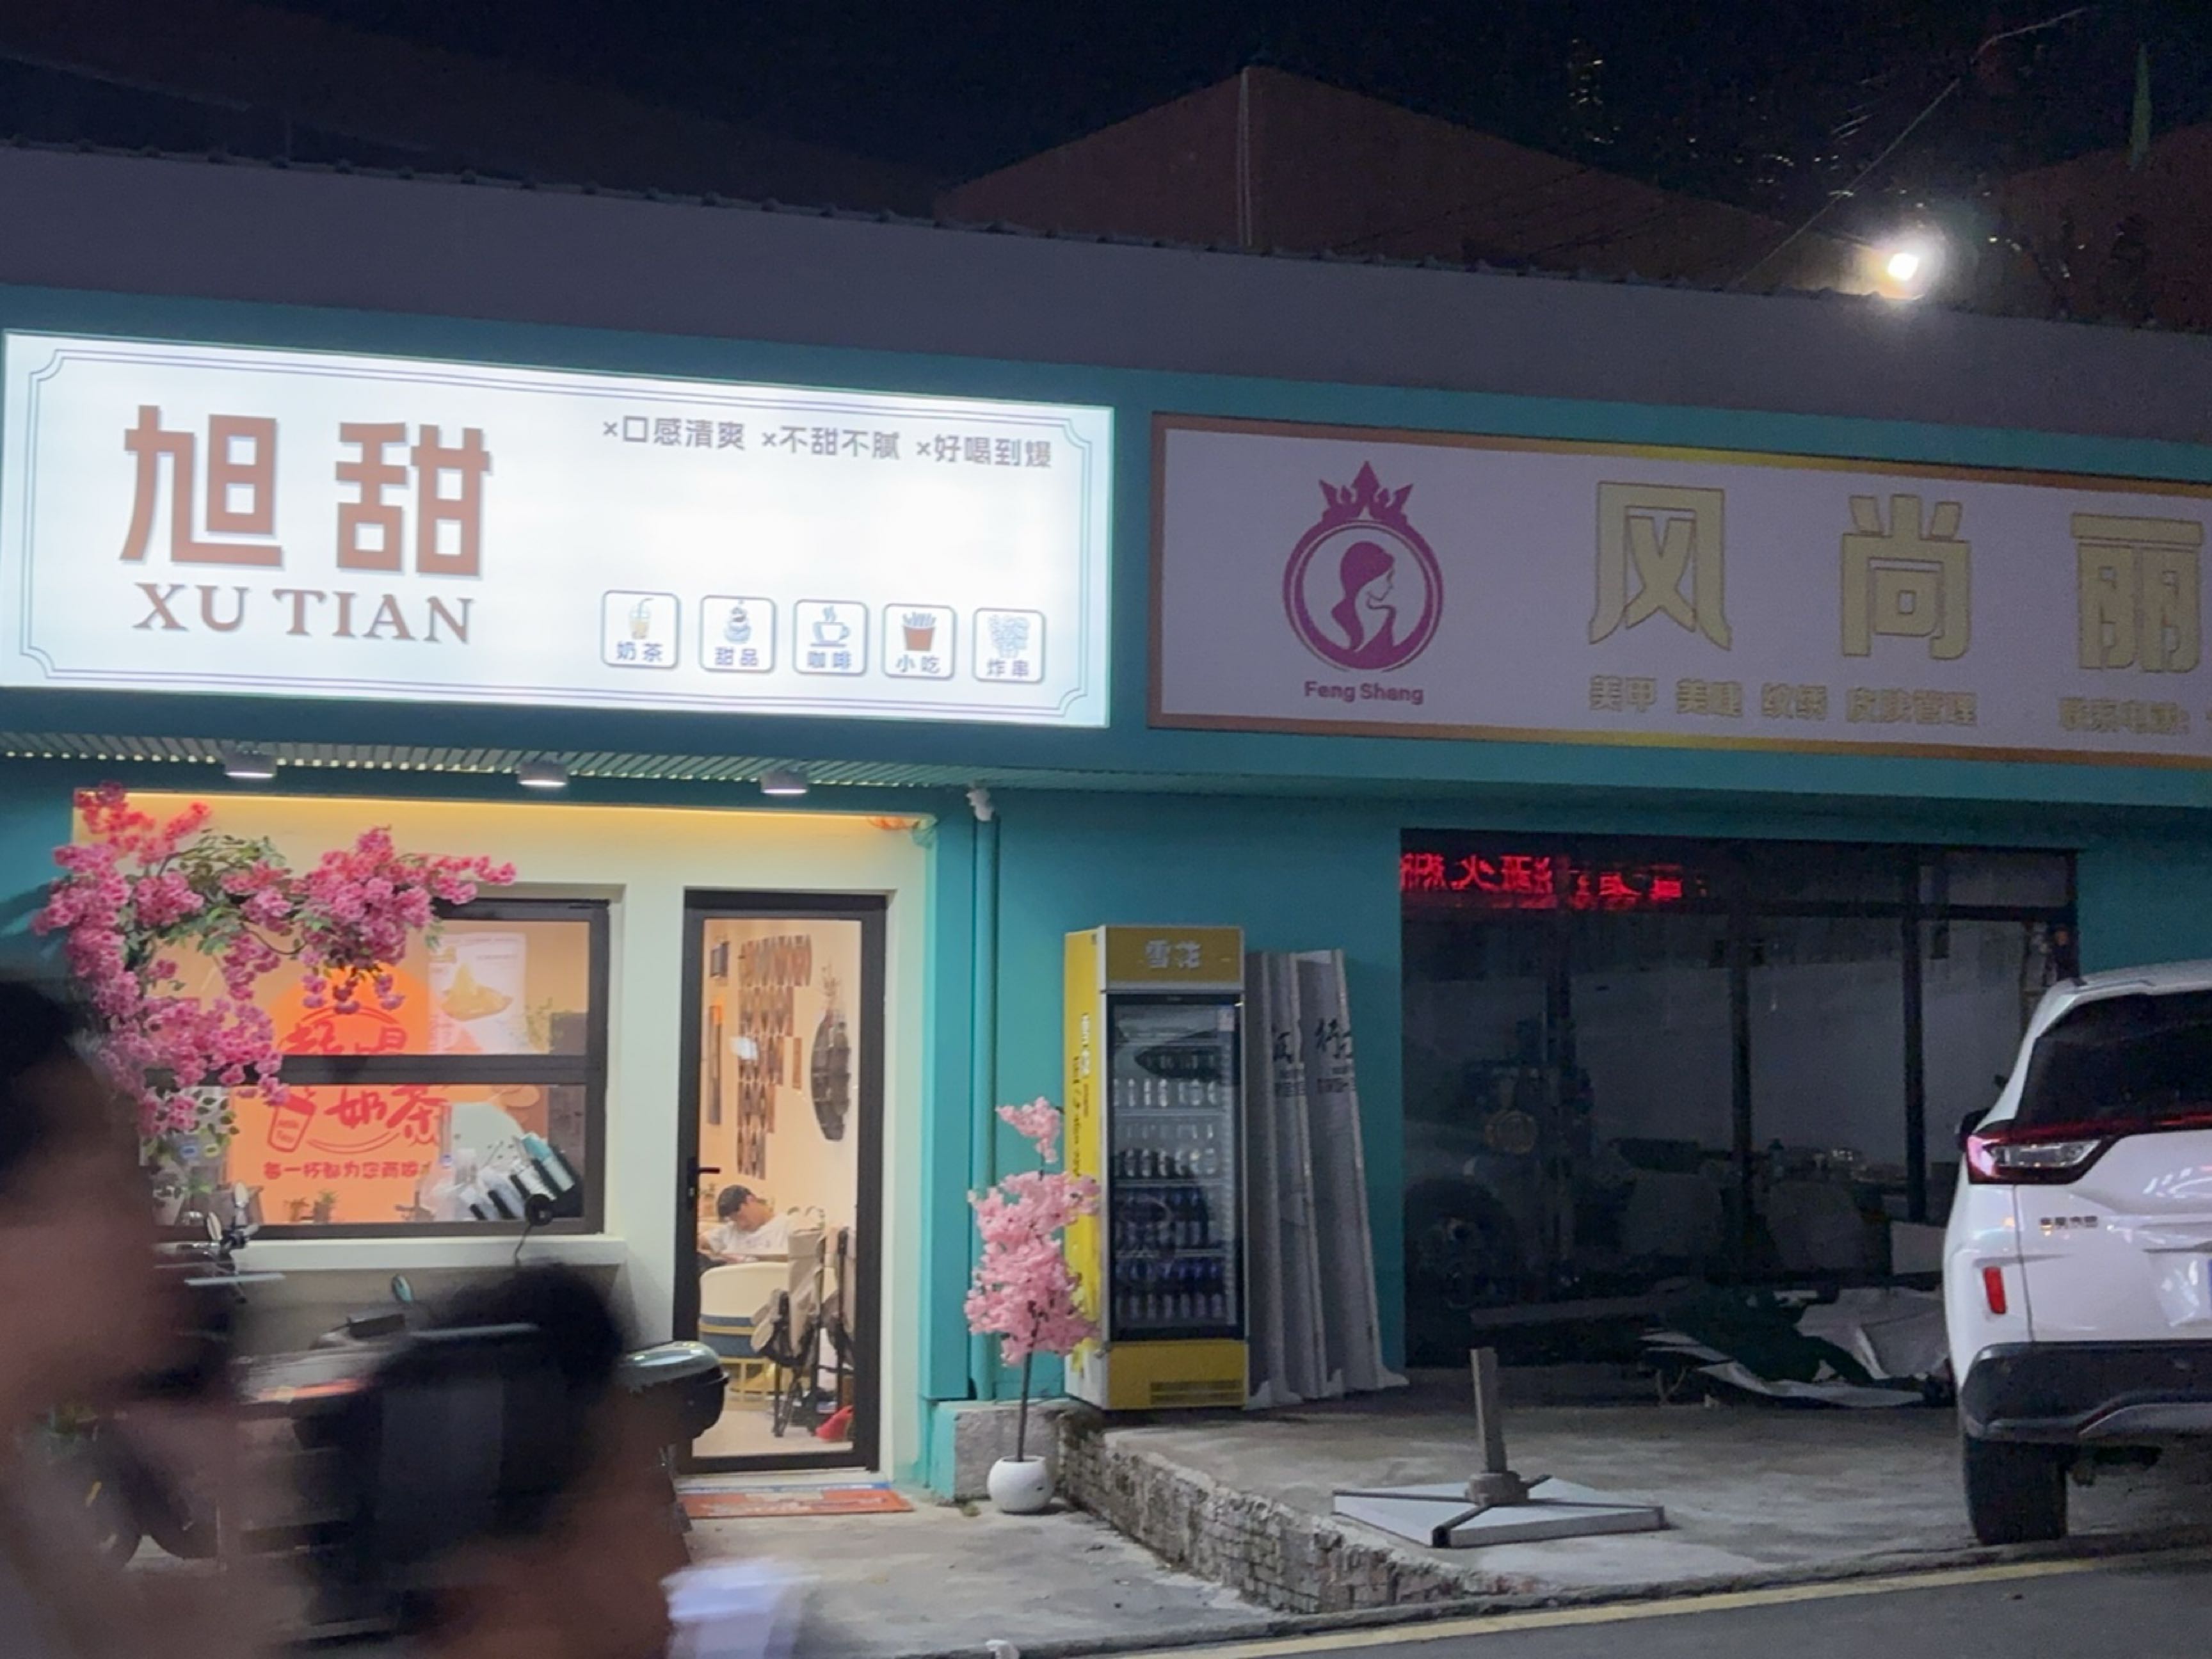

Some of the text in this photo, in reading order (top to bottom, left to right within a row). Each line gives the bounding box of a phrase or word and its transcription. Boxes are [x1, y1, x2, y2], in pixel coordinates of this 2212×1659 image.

[119, 405, 493, 577] 旭甜
[273, 588, 474, 644] TIAN
[616, 641, 662, 662] 奶茶
[714, 646, 758, 666] 甜品
[807, 650, 851, 670] 咖啡
[895, 654, 940, 673] 小吃
[1304, 681, 1423, 705] Feng Shang
